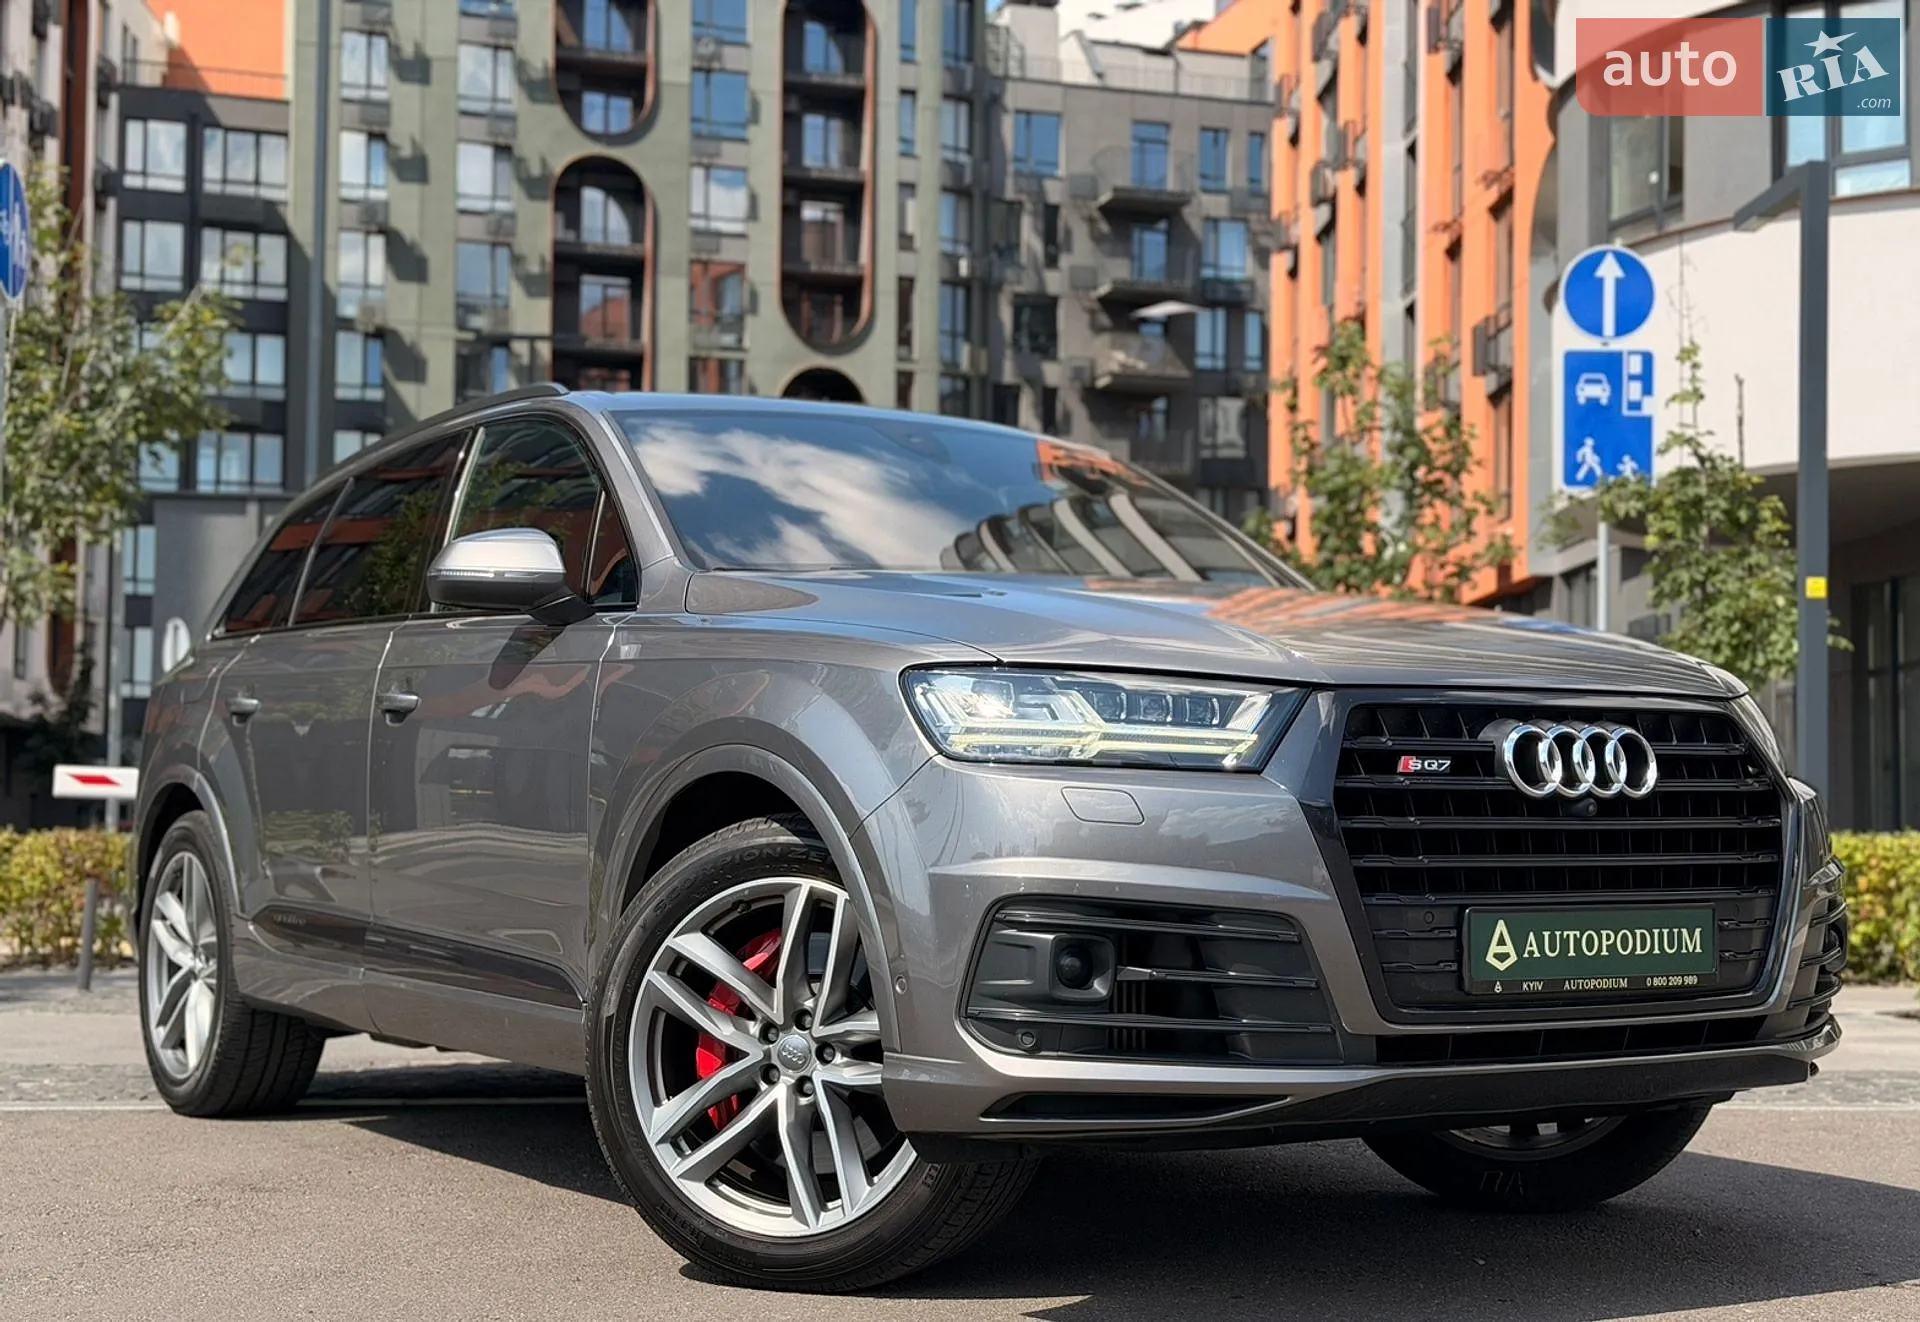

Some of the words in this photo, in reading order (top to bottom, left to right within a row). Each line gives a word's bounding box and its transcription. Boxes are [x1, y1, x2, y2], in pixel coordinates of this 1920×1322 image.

[1405, 757, 1452, 772] SQ7
[1522, 927, 1703, 958] AUTOPODIUM
[1522, 981, 1544, 992] KYIV
[1563, 978, 1628, 991] AUTOPODIUM
[1646, 976, 1652, 987] 0
[1653, 976, 1668, 986] 800
[1668, 975, 1682, 986] 209
